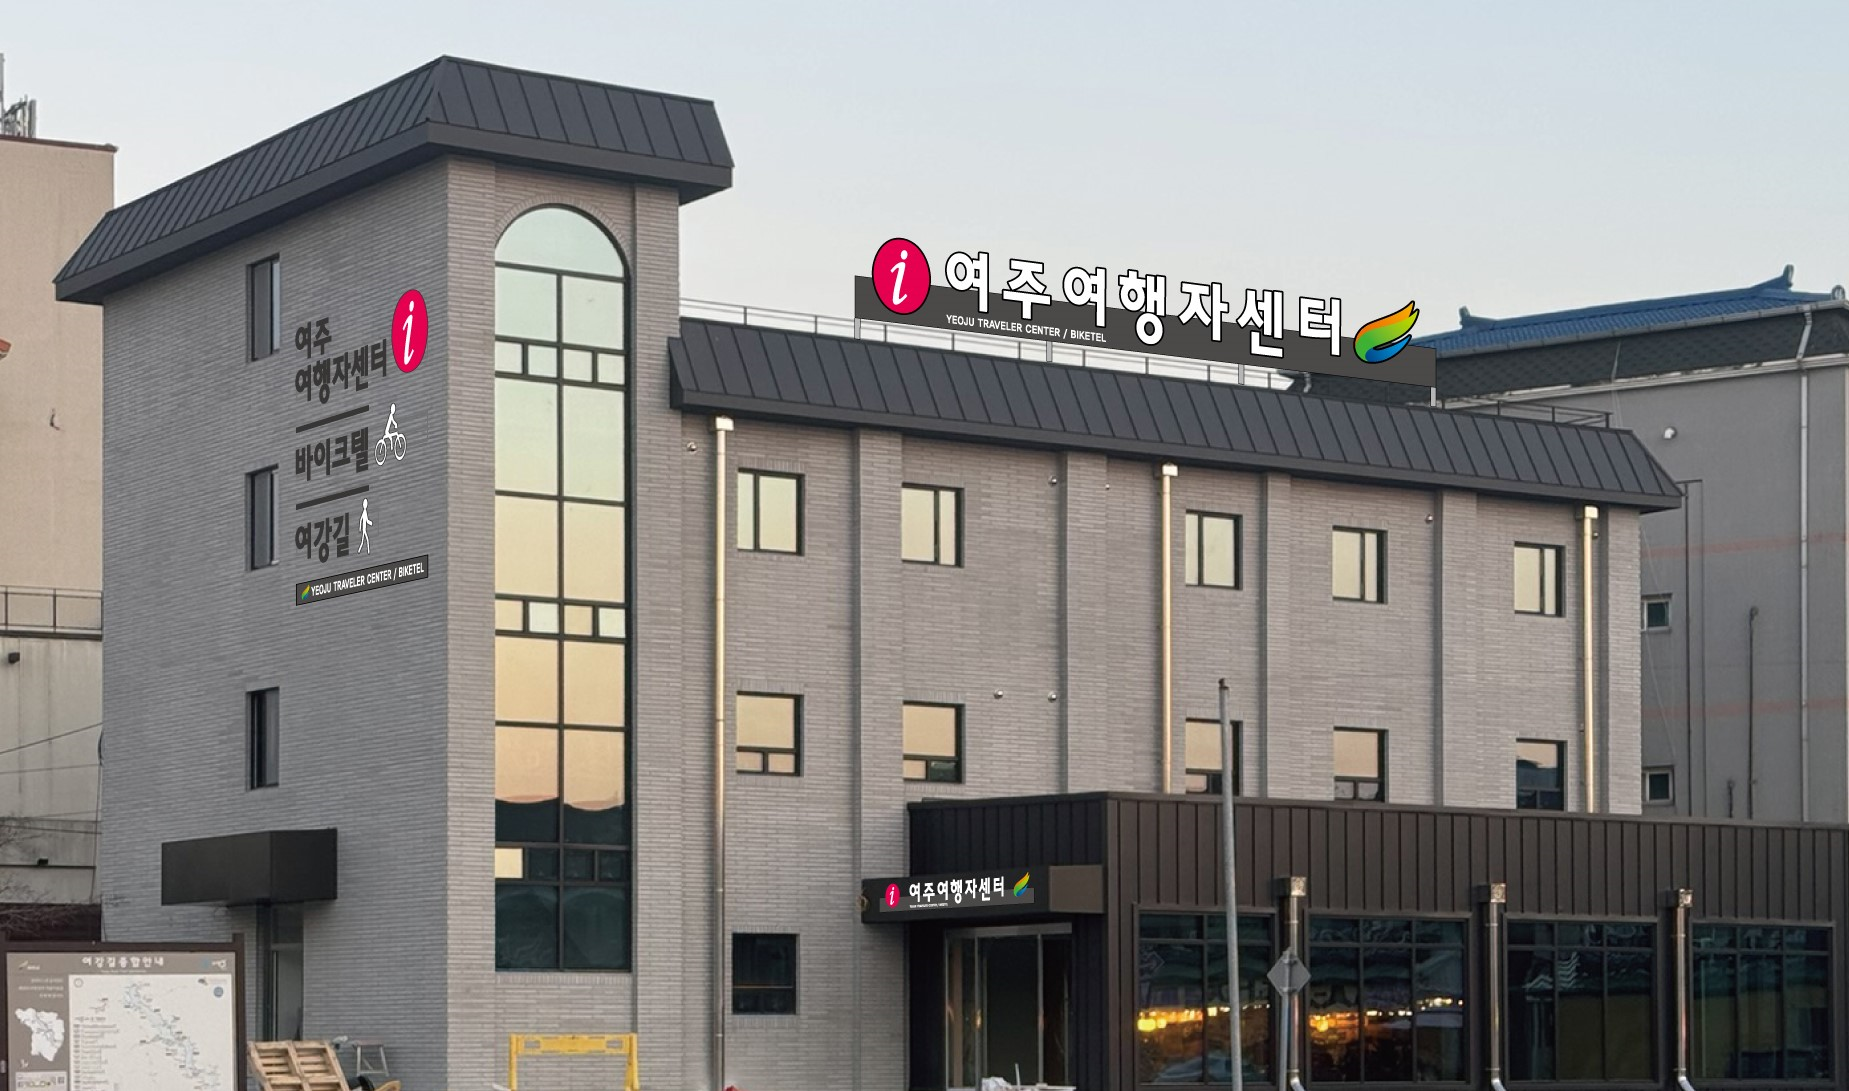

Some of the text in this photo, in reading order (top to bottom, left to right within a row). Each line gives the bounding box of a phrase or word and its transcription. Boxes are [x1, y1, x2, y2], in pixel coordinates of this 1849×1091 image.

[945, 251, 1342, 358] 여주여행자센터
[295, 317, 332, 359] 여주
[946, 314, 975, 327] YEOJU
[978, 318, 1023, 333] TRAVELER
[1025, 324, 1061, 337] CENTER
[1070, 329, 1107, 343] BIKETEL
[295, 338, 387, 404] 여행자센터
[295, 426, 369, 481] 바이크텔
[295, 512, 350, 563] 여강길
[311, 582, 331, 597] YEOJU
[333, 576, 366, 592] TRAVELER
[366, 570, 392, 585] CENTER
[398, 562, 425, 578] BIKETEL
[909, 876, 1005, 904] 여주여행자센터
